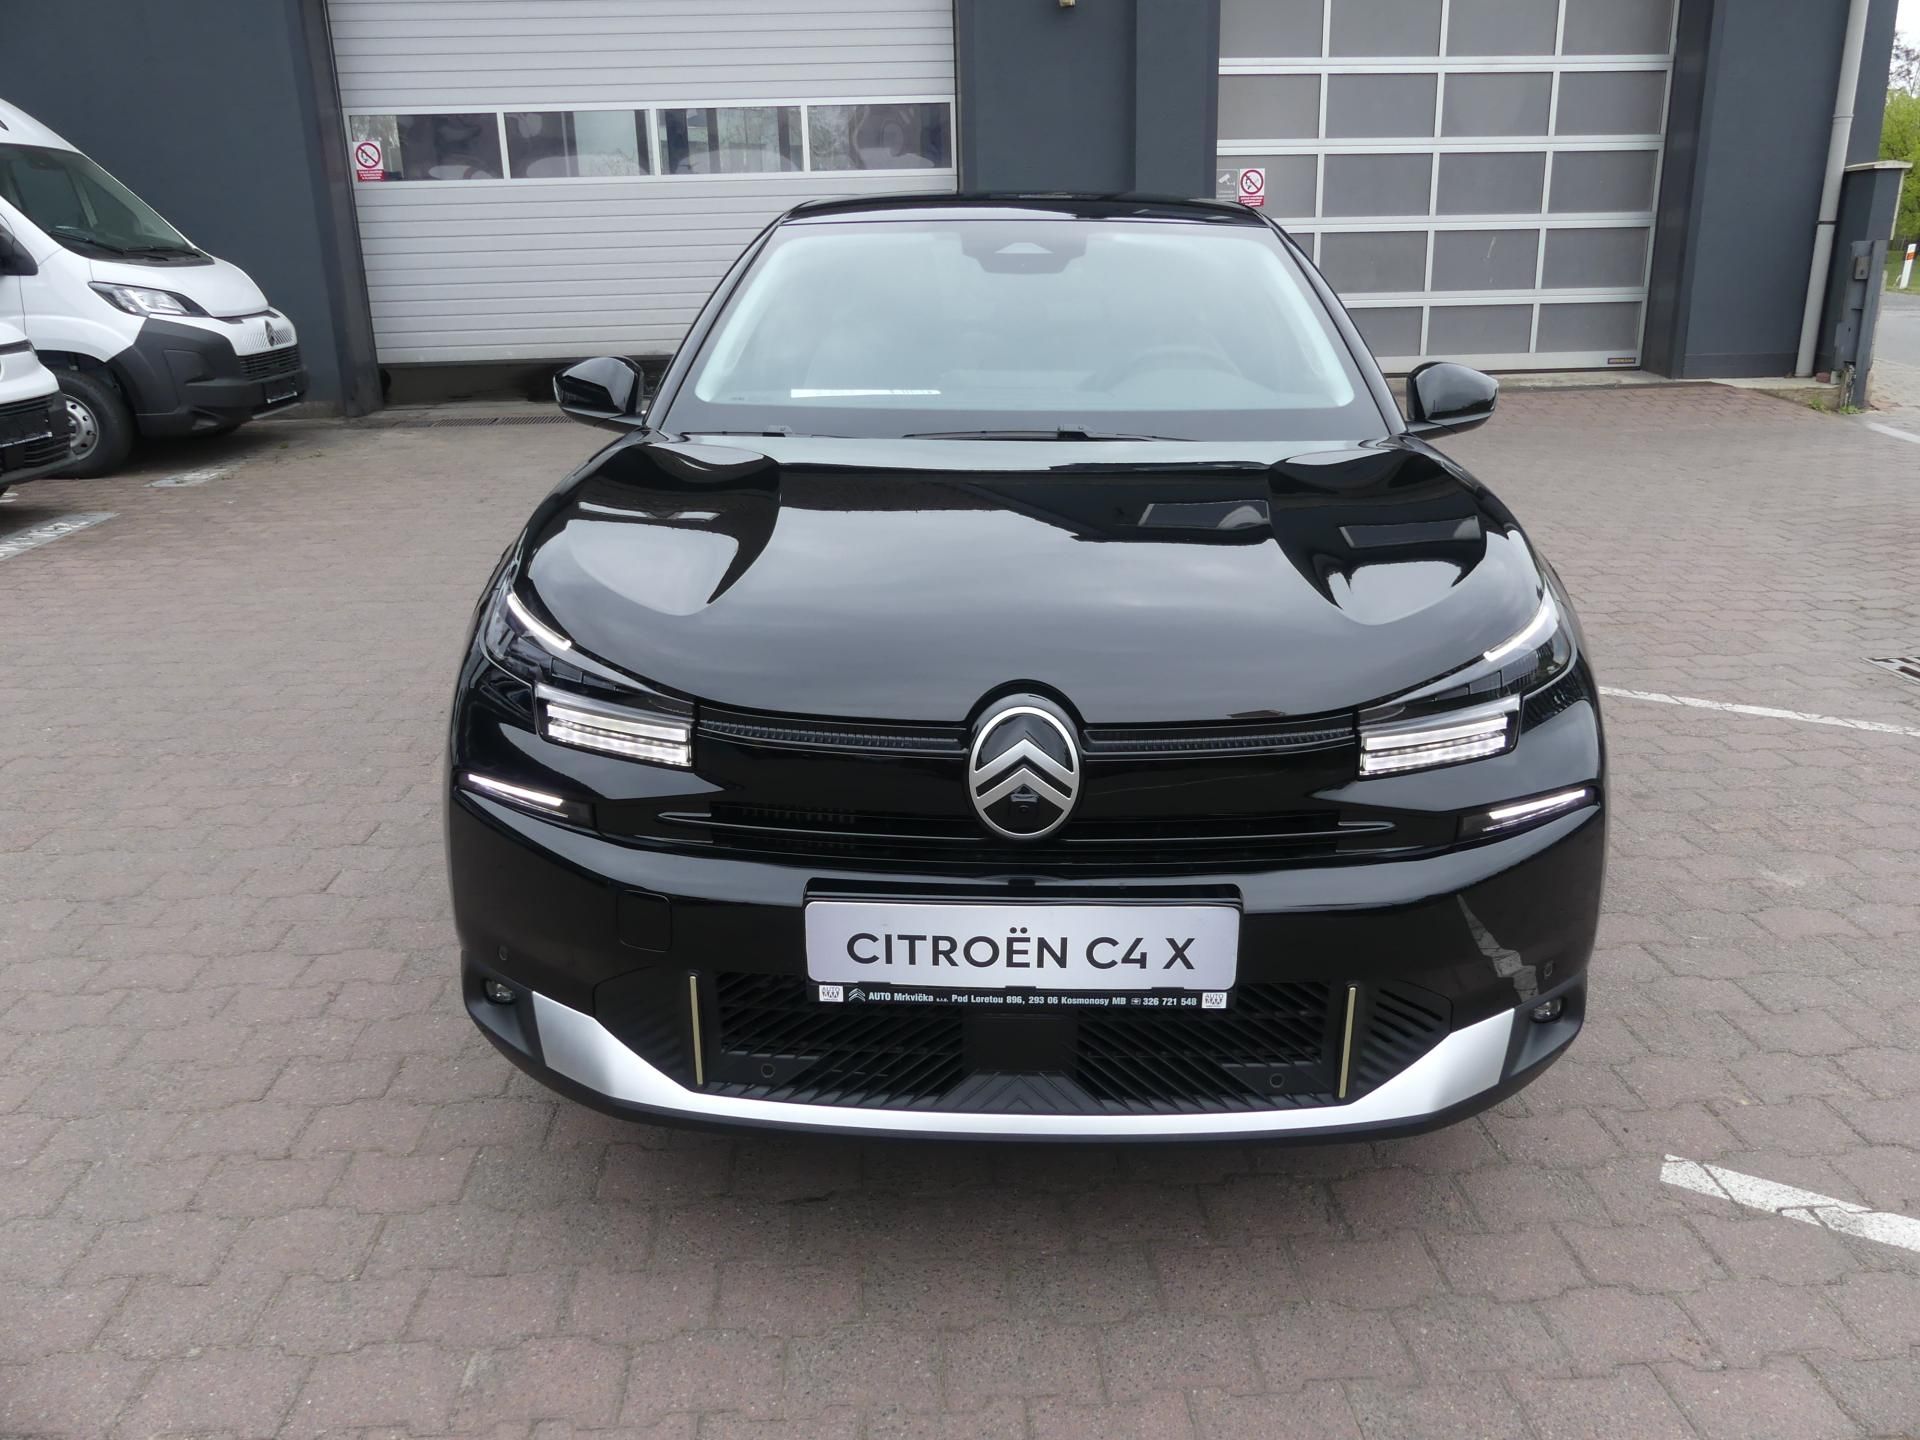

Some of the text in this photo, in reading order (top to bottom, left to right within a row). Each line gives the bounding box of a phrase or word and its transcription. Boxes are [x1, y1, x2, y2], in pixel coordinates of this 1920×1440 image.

[846, 926, 1195, 970] CITROËN C4 X
[868, 991, 891, 1001] AUTO
[893, 992, 934, 1003] Mrkvička
[951, 994, 968, 1003] Pod
[970, 994, 1004, 1004] Loretou
[1006, 995, 1025, 1005] 896,
[1028, 996, 1045, 1005] 293
[1047, 996, 1059, 1005] 06
[1061, 996, 1110, 1007] Kosmonosy
[1111, 997, 1127, 1006] MB
[1142, 997, 1160, 1006] 326
[1161, 997, 1178, 1006] 721
[1180, 997, 1198, 1006] 548
